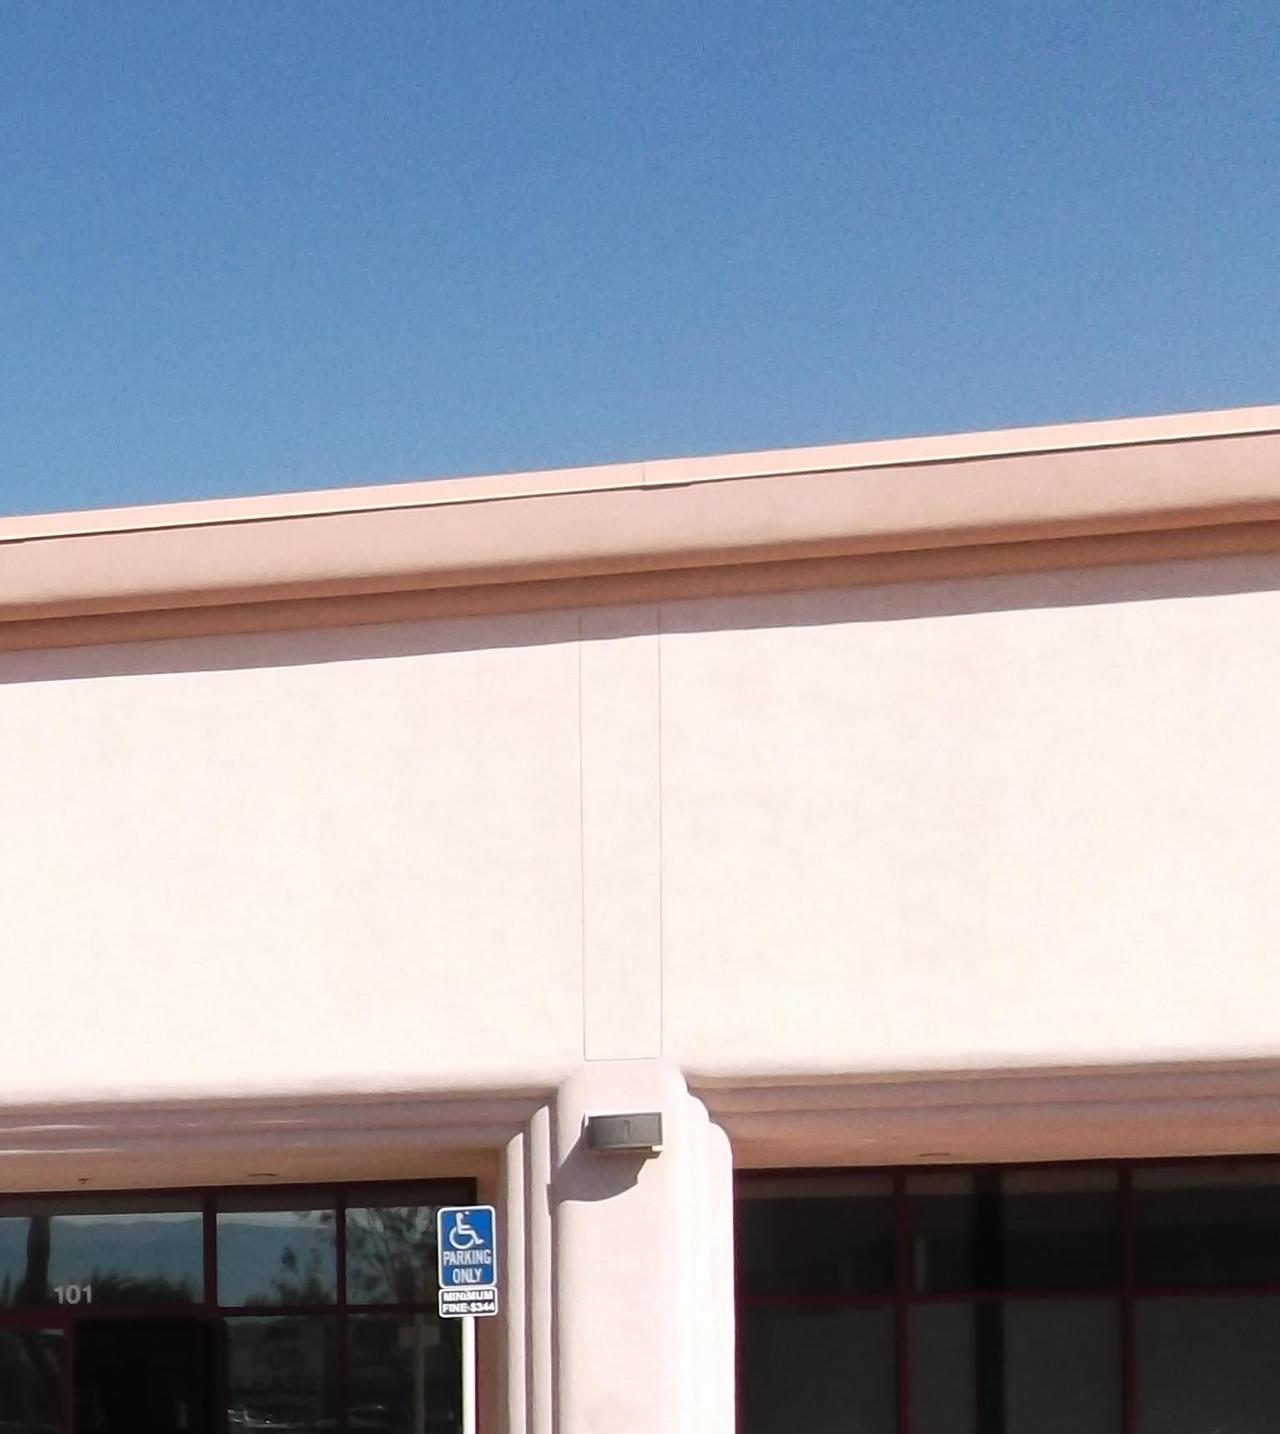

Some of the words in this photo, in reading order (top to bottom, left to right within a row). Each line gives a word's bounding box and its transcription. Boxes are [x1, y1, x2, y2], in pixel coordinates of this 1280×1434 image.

[443, 1249, 492, 1266] PARKING
[452, 1268, 482, 1284] ONLY
[53, 1285, 91, 1304] 101
[443, 1290, 494, 1302] MINIMUM
[442, 1303, 468, 1313] FINE
